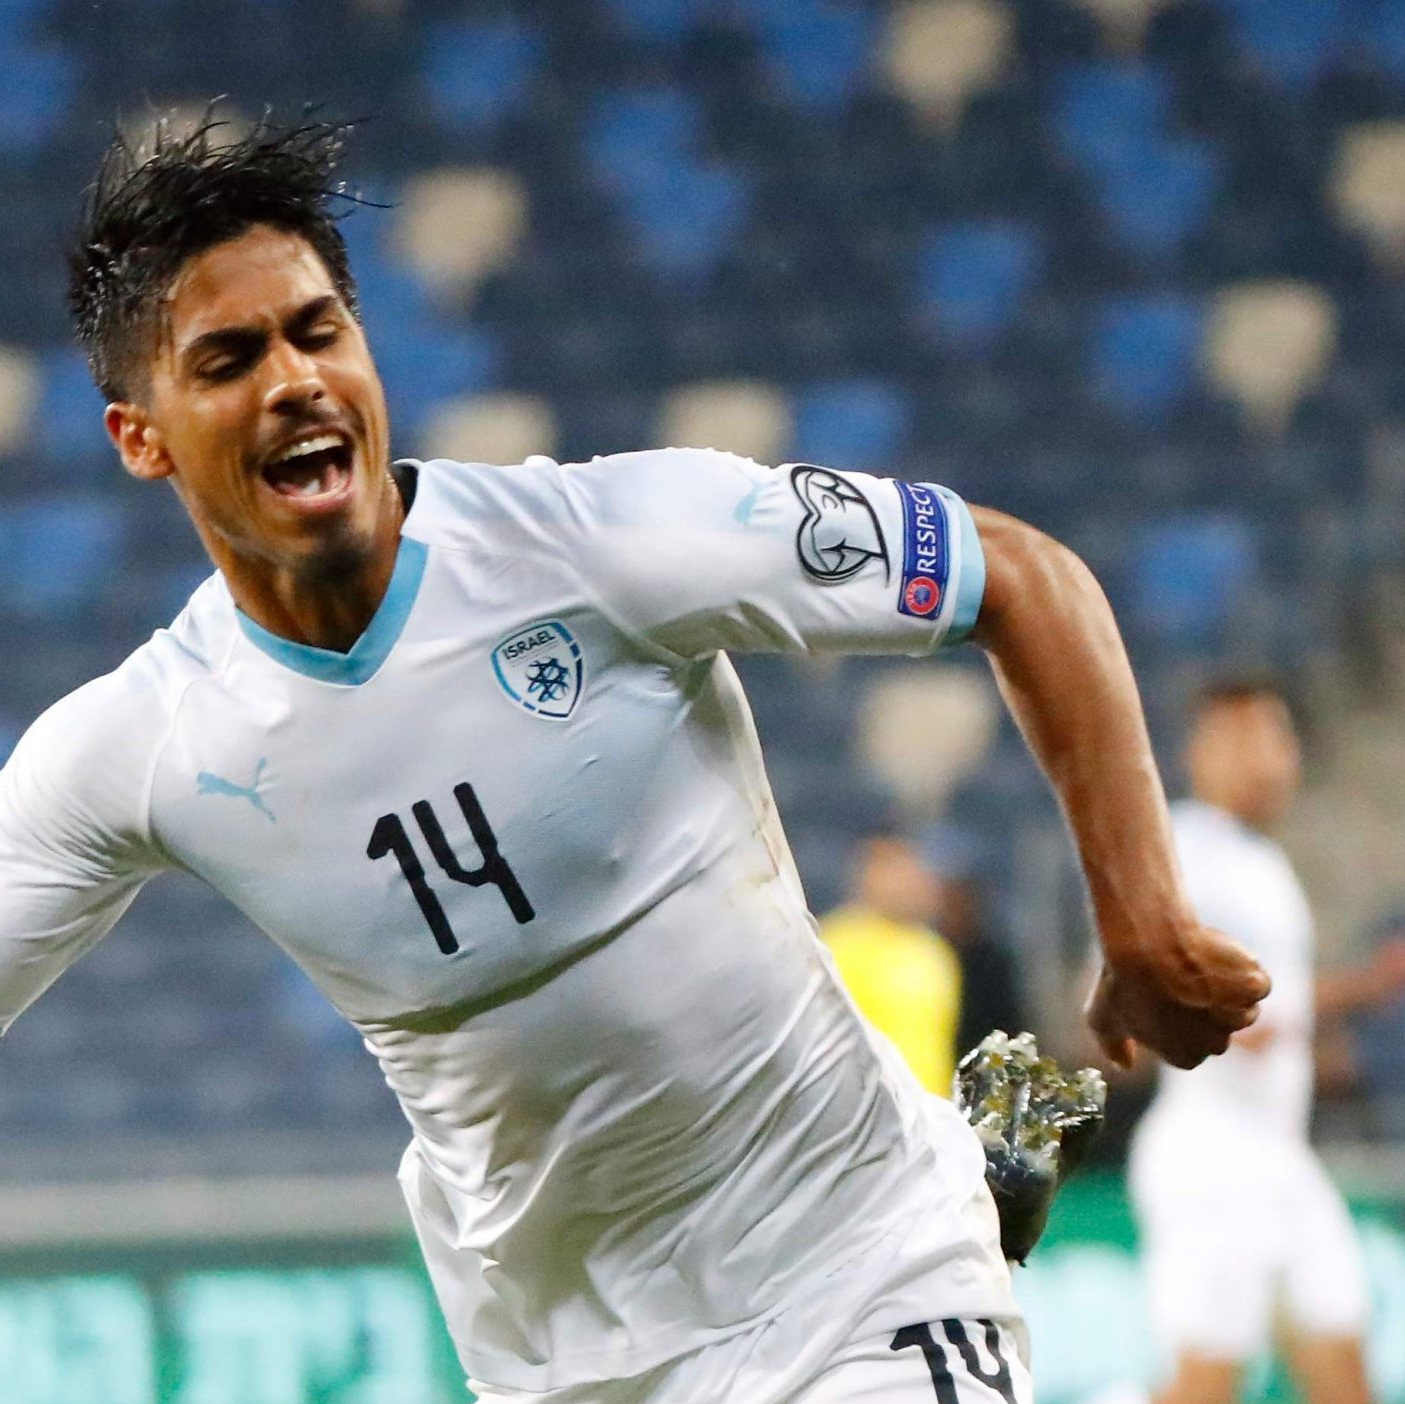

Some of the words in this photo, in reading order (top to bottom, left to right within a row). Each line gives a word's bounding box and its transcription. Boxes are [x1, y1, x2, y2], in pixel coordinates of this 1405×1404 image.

[906, 482, 937, 574] RESPECT
[502, 630, 556, 660] ISRAEL
[366, 781, 536, 956] 14
